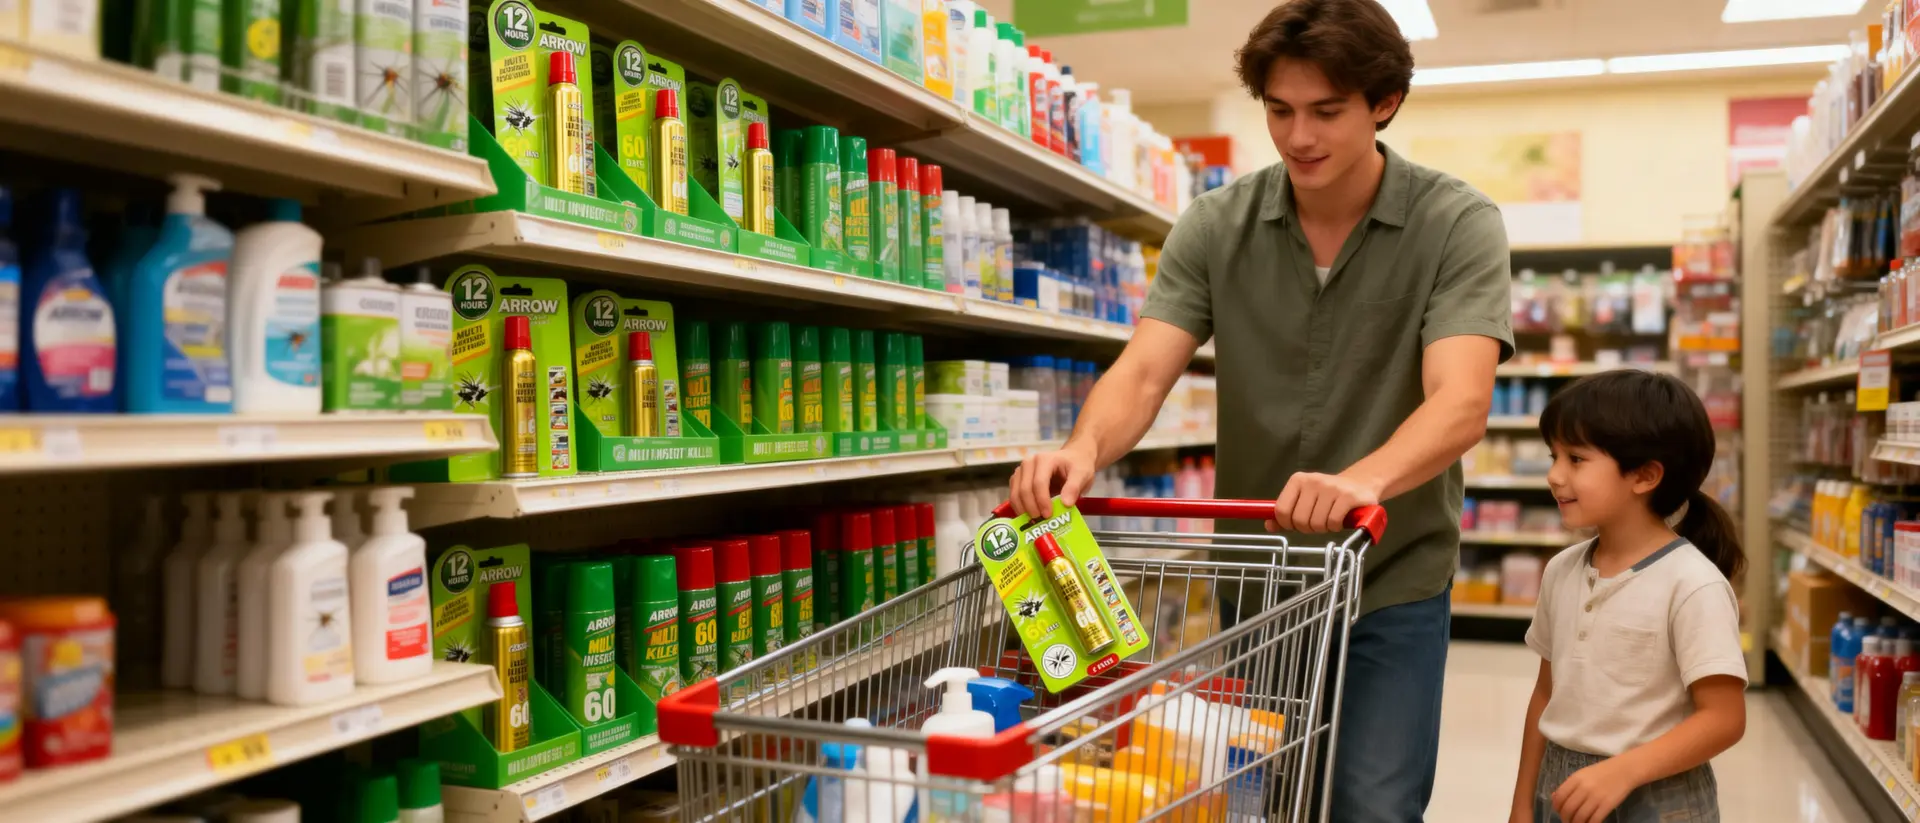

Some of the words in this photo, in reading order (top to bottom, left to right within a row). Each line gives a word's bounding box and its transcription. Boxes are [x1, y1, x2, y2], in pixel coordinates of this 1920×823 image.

[503, 6, 529, 32] 12
[504, 29, 529, 41] HOURS
[538, 33, 587, 56] ARROW
[623, 51, 642, 72] 12
[724, 87, 738, 106] 12
[622, 134, 646, 158] 60
[461, 278, 488, 300] 12
[460, 301, 488, 310] HOURS
[498, 298, 559, 314] ARROW
[593, 301, 614, 320] 12
[623, 318, 668, 331] ARROW
[986, 526, 1013, 550] 12
[1025, 511, 1072, 545] ARROW
[448, 552, 469, 577] 12
[480, 565, 523, 583] ARROW
[695, 619, 717, 646] 60
[510, 700, 530, 728] 60
[583, 687, 616, 723] 60
